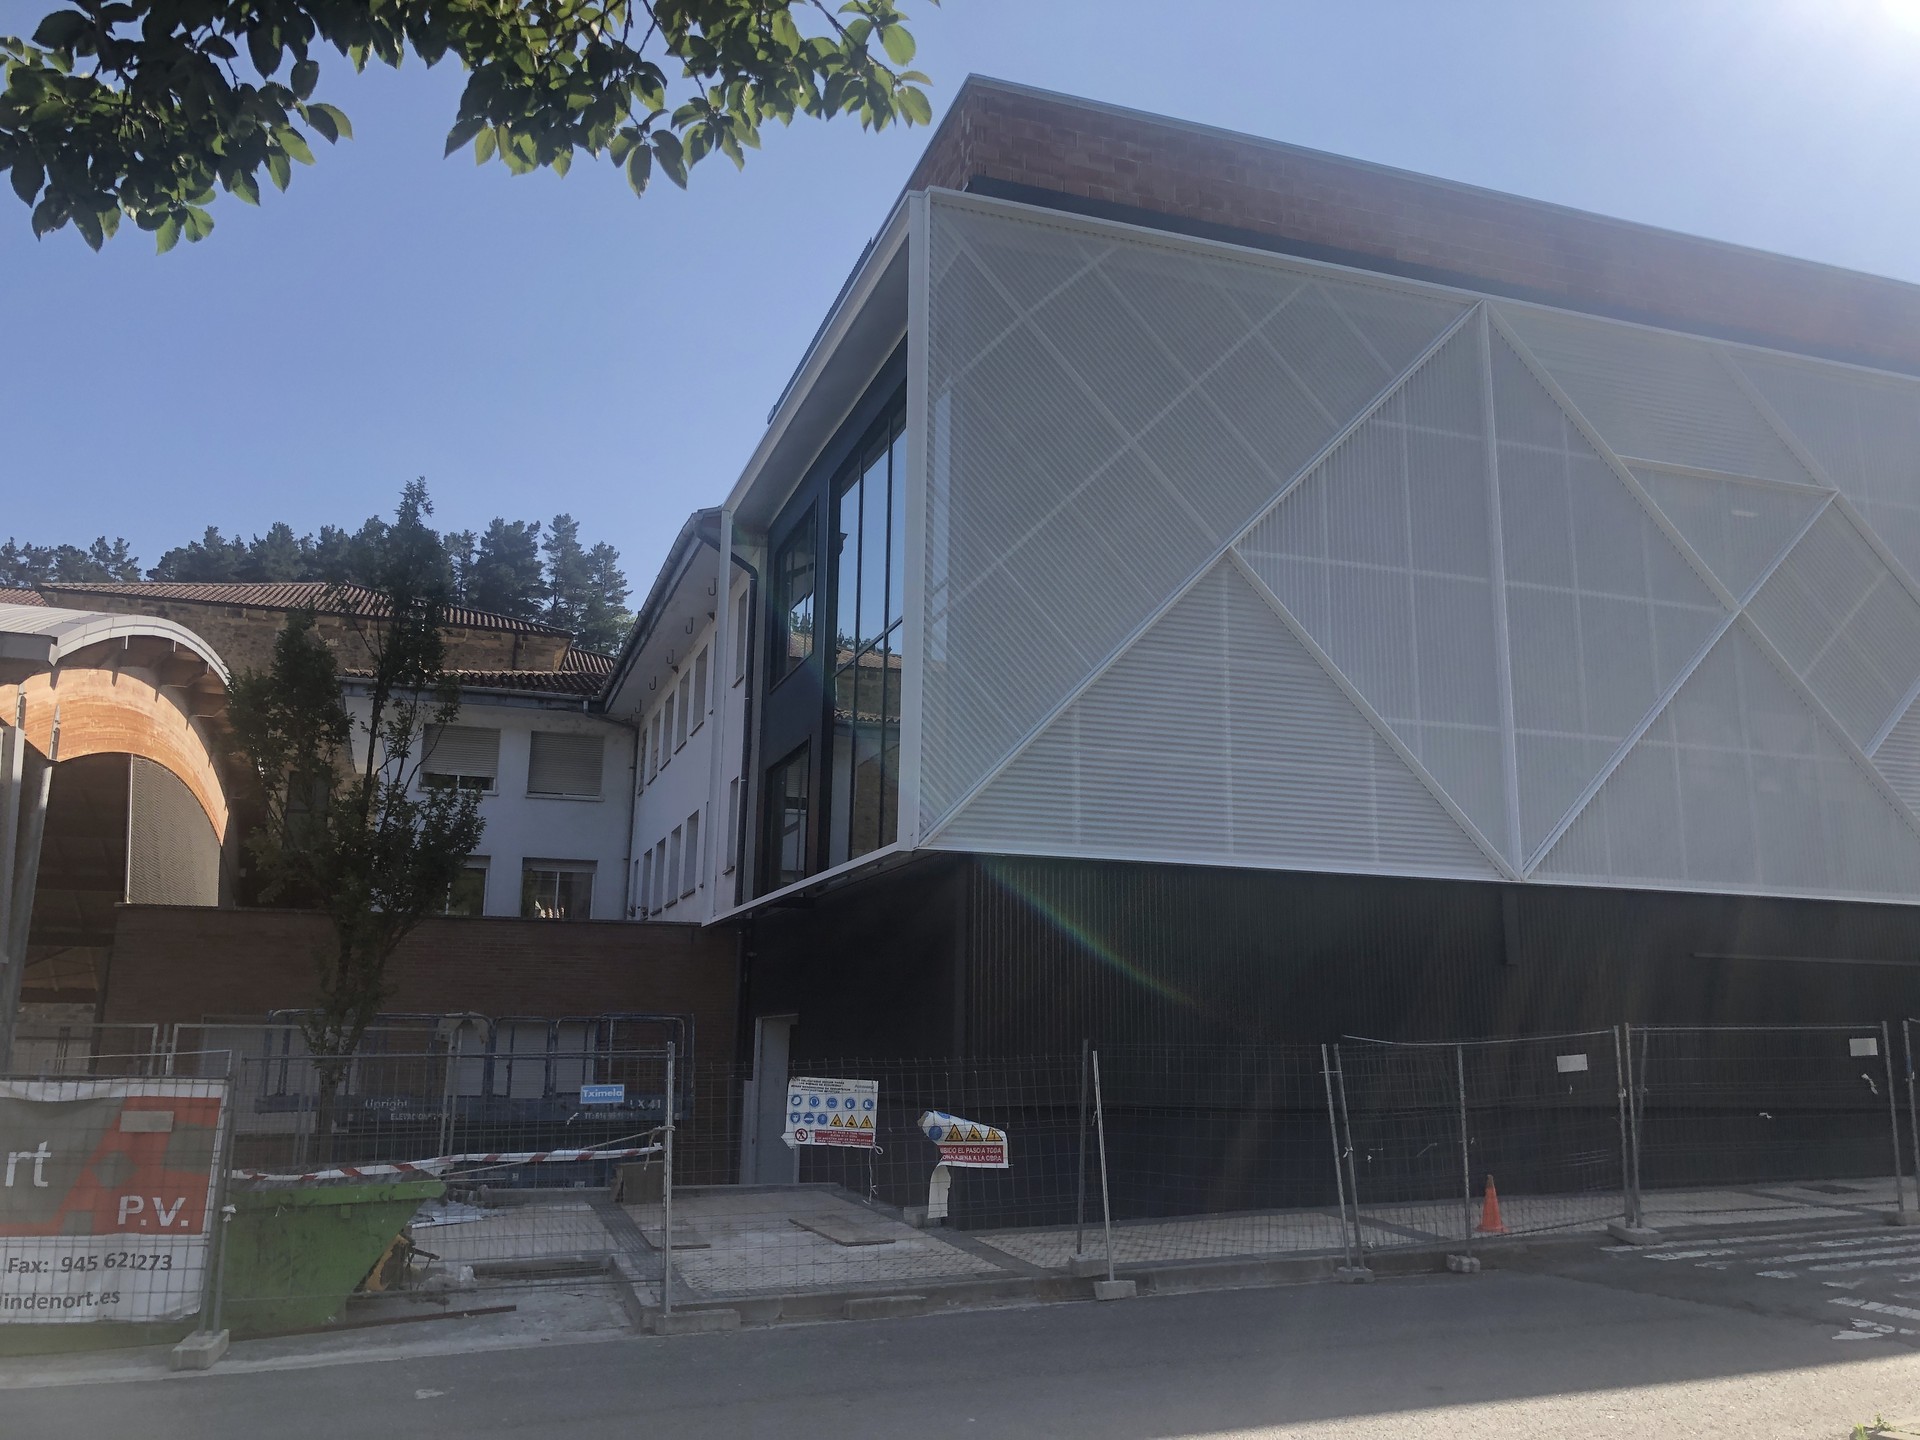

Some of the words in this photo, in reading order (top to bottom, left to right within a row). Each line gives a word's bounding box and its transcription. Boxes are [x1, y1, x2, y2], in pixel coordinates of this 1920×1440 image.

[583, 1089, 622, 1098] Tximela
[365, 1098, 407, 1111] Upright
[7, 1257, 49, 1274] Fax:
[60, 1255, 98, 1272] 945
[103, 1251, 173, 1271] 621273
[0, 1290, 121, 1310] indenort.es
